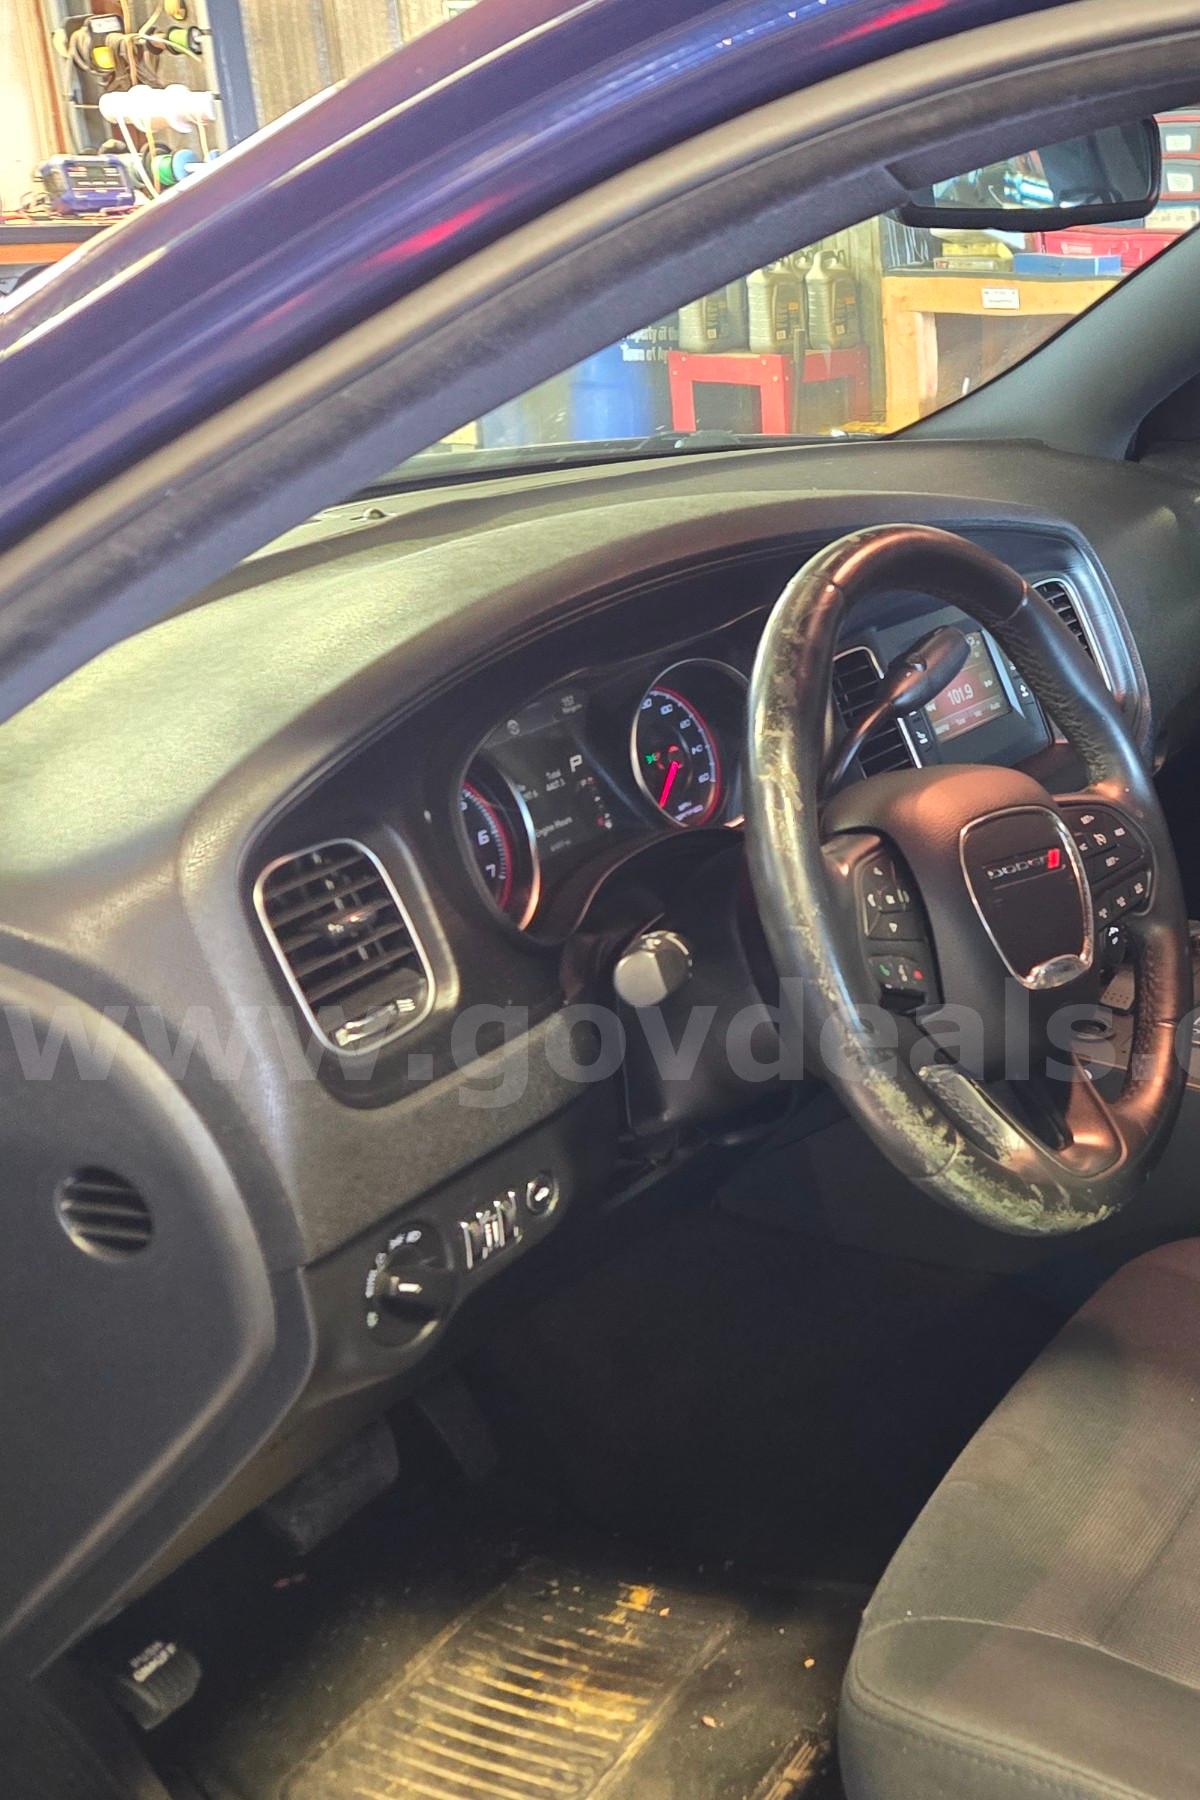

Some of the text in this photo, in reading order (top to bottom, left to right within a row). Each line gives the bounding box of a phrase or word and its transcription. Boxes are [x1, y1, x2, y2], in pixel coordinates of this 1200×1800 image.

[947, 683, 974, 706] 101.9
[569, 754, 583, 773] P
[477, 829, 490, 846] 6
[485, 863, 496, 878] 7
